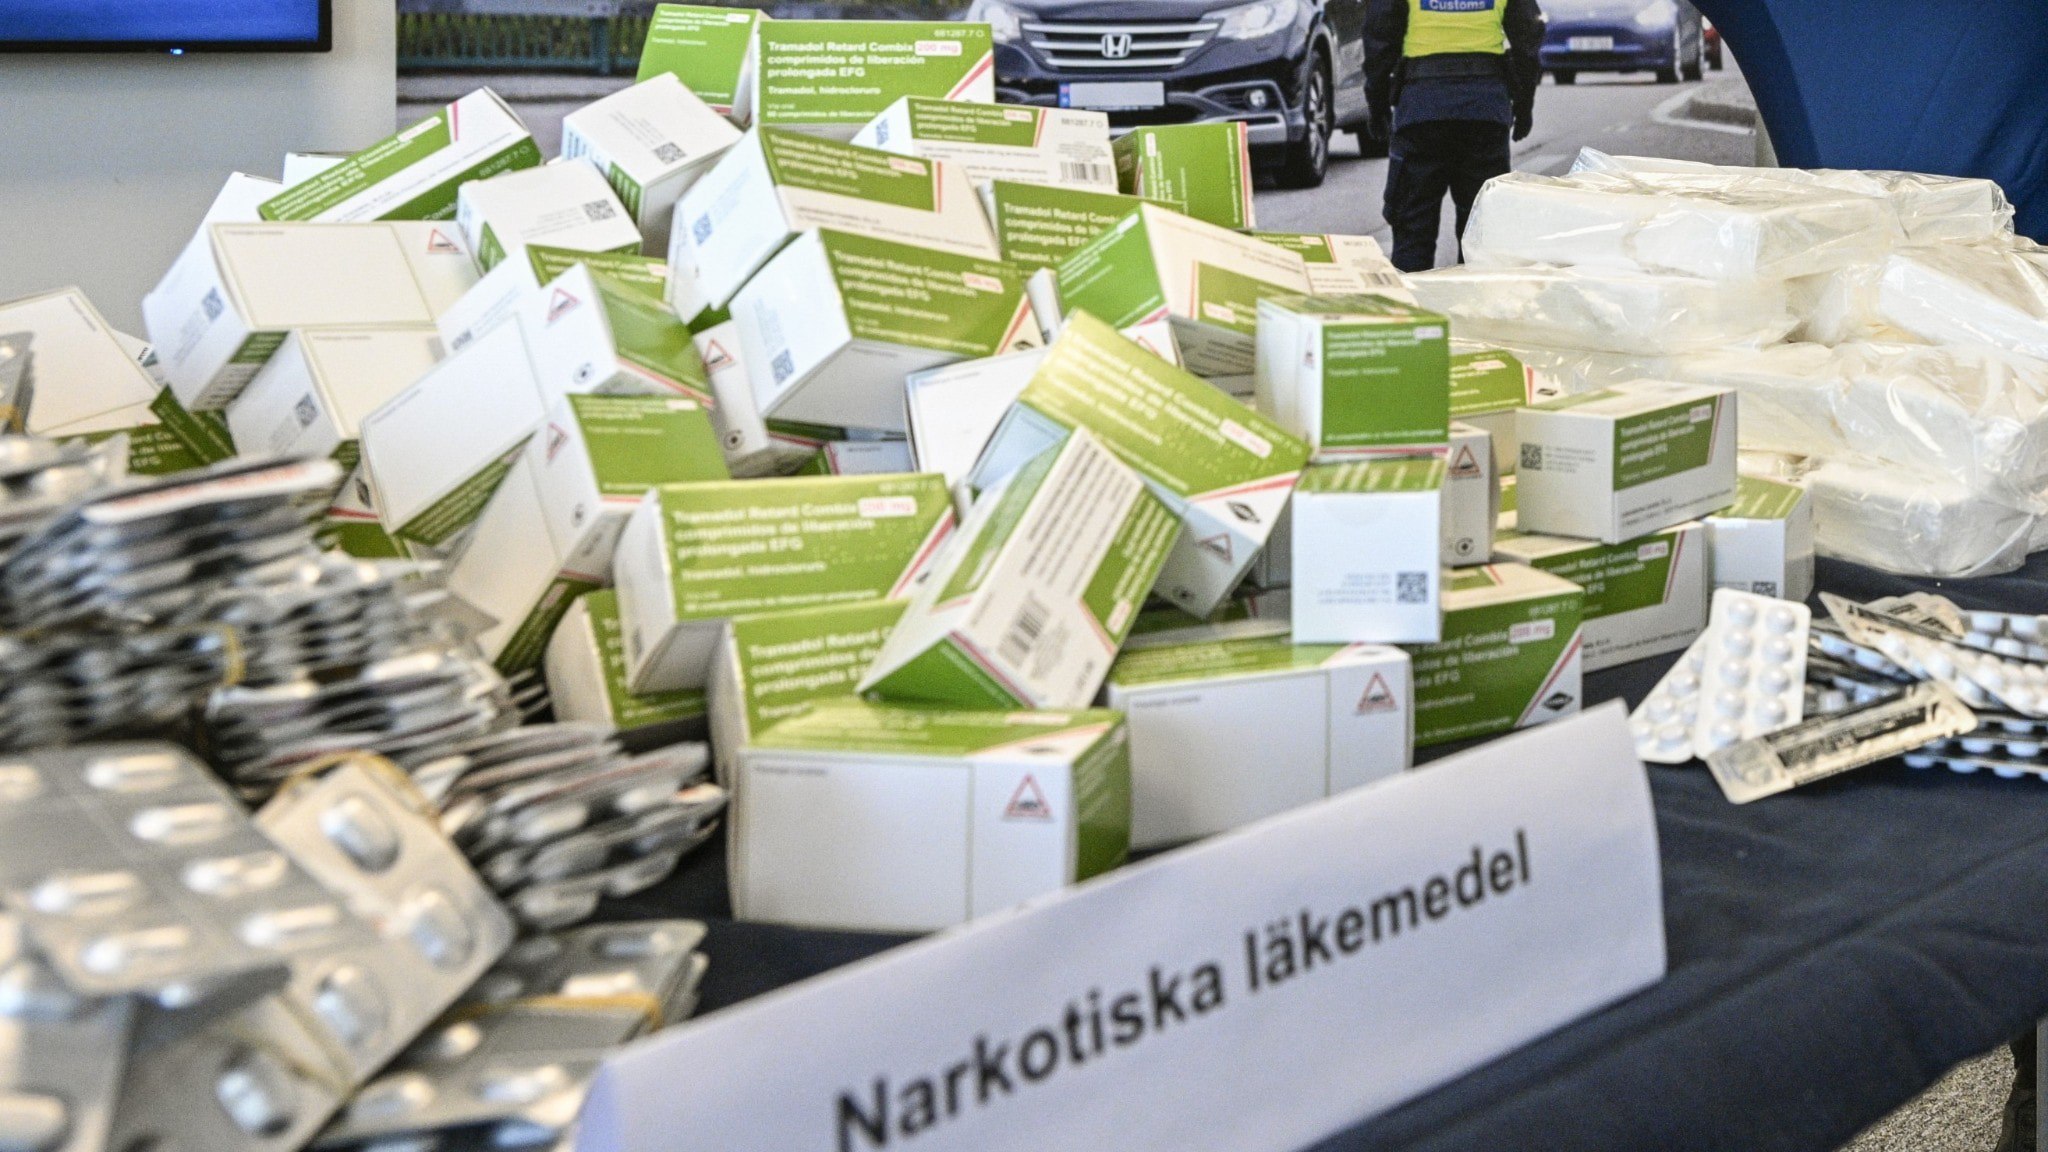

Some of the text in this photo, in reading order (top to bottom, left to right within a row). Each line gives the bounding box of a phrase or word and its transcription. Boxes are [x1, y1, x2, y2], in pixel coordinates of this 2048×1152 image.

[1429, 0, 1486, 10] Customs
[767, 54, 925, 66] comprimidos de liberación
[768, 41, 959, 54] Tramadol Retard Combix 200 mg
[767, 68, 866, 79] prolongada EFG
[674, 508, 746, 525] Tramadol
[748, 505, 799, 520] Retard
[802, 502, 857, 518] Combix
[675, 517, 875, 544] comprimidos de liberación
[677, 536, 804, 561] prolongada EFG
[750, 630, 880, 659] Tramadol Retard
[751, 652, 856, 677] comprimidos
[753, 669, 847, 697] prolongada
[835, 830, 1531, 1152] Narkotiska läkemedel
